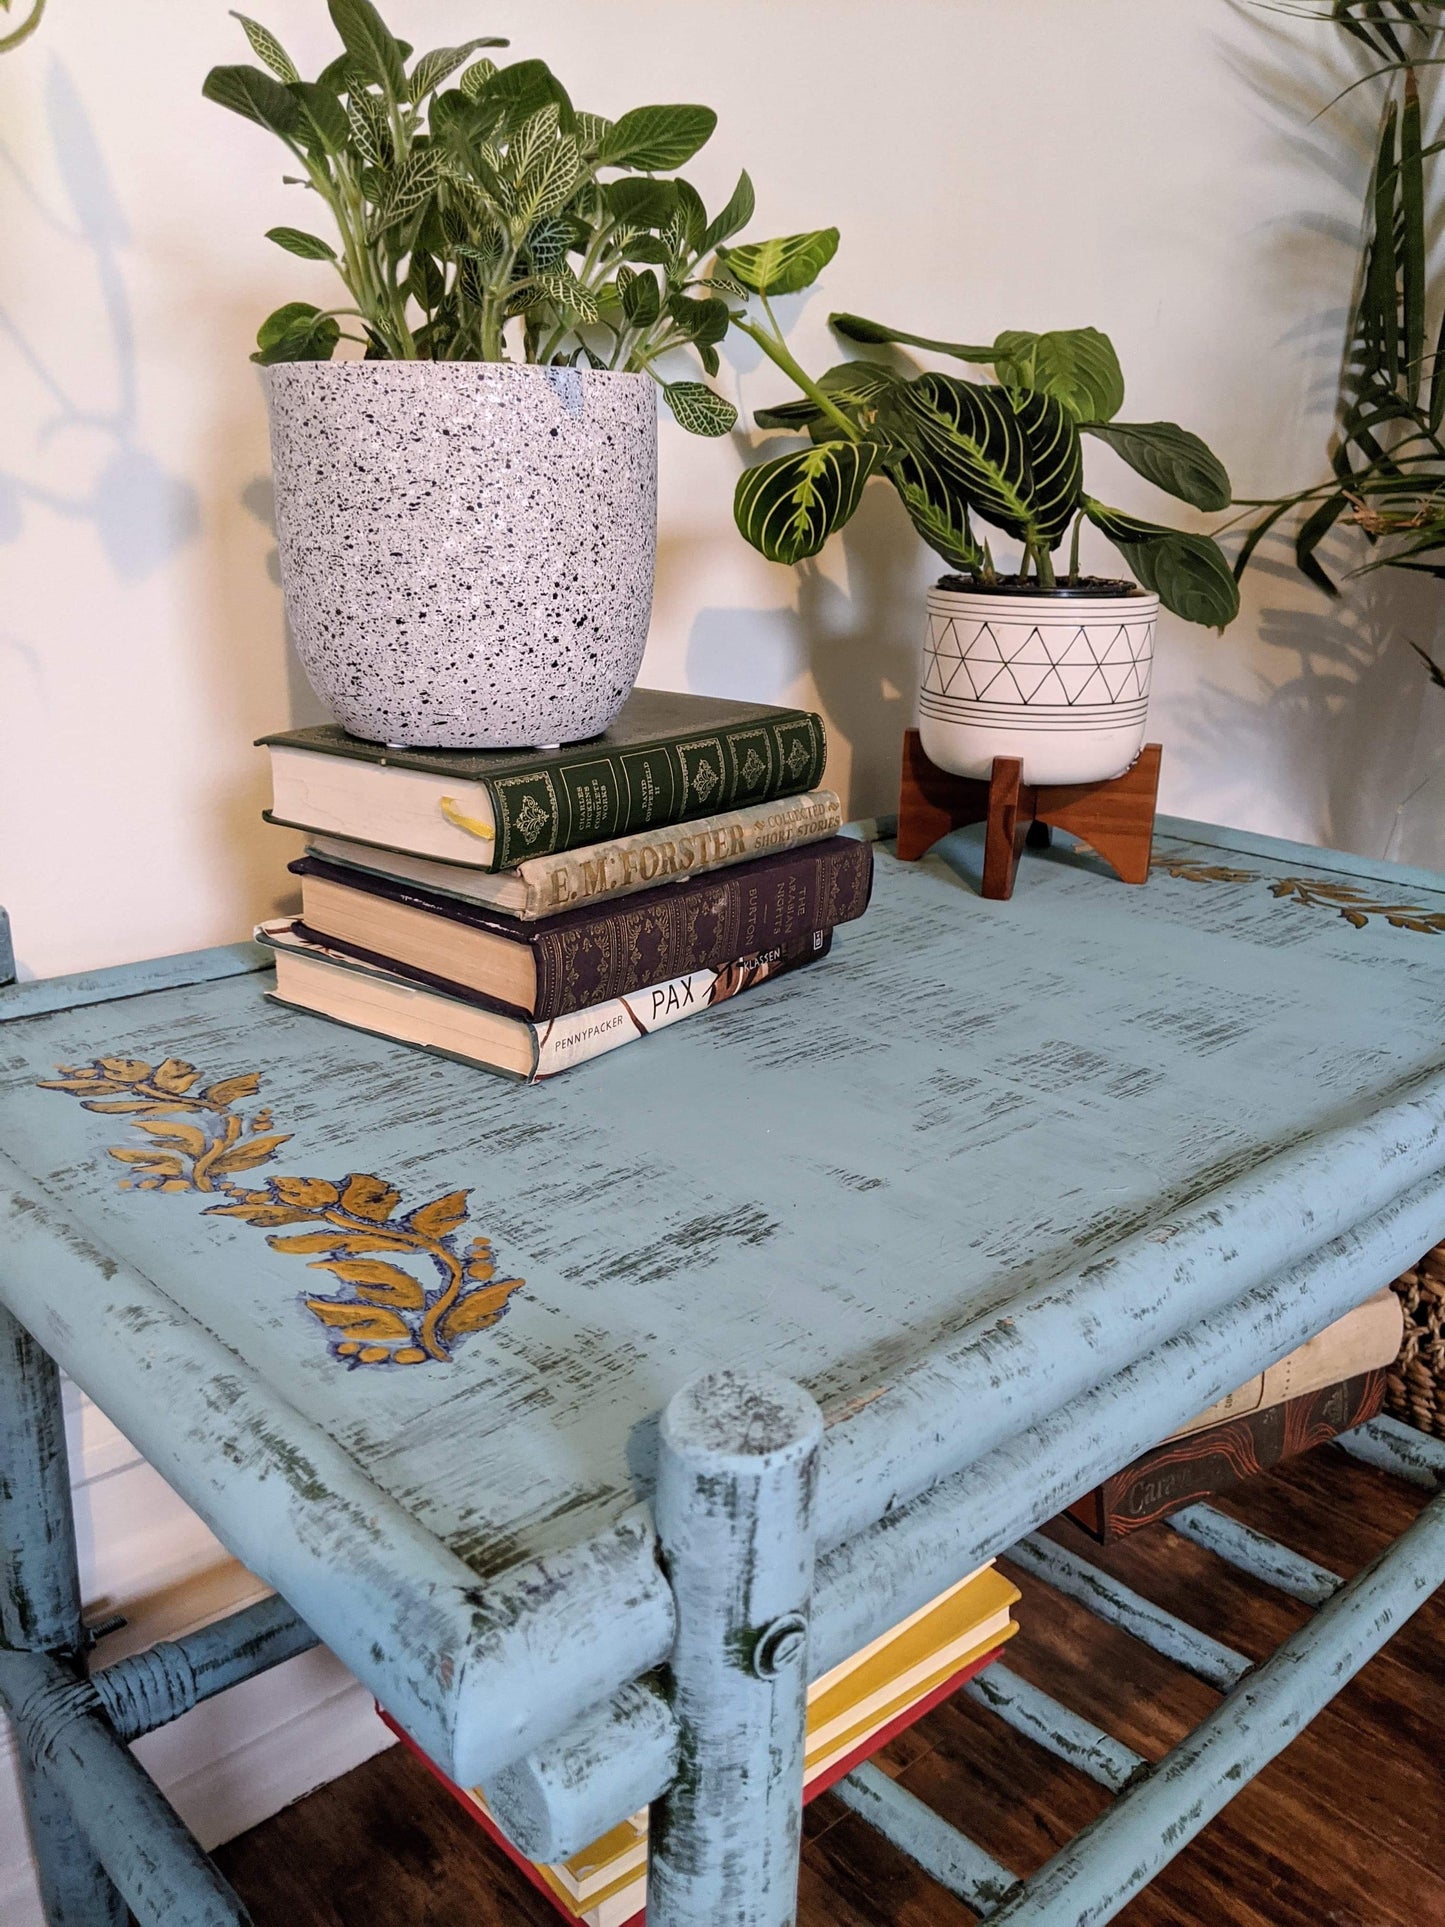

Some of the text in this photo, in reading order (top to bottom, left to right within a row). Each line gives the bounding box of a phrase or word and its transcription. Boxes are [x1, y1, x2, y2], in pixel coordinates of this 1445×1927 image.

[576, 786, 585, 831] CHARLES
[584, 785, 593, 829] DICKENS
[592, 779, 602, 830] COMPLETE
[601, 785, 609, 821] WORKS
[643, 761, 654, 822] COPPERFIELD
[767, 803, 826, 828] COLLECTED
[754, 816, 840, 850] SHORT STORIES
[546, 867, 577, 906] E.
[619, 824, 747, 886] FORSTER
[745, 888, 758, 946] BURTON
[774, 882, 785, 935] NIGHTS
[784, 876, 797, 934] ARABIAN
[797, 886, 807, 916] THE
[555, 948, 781, 1052] PENNYPACKER PAX KLASSEN
